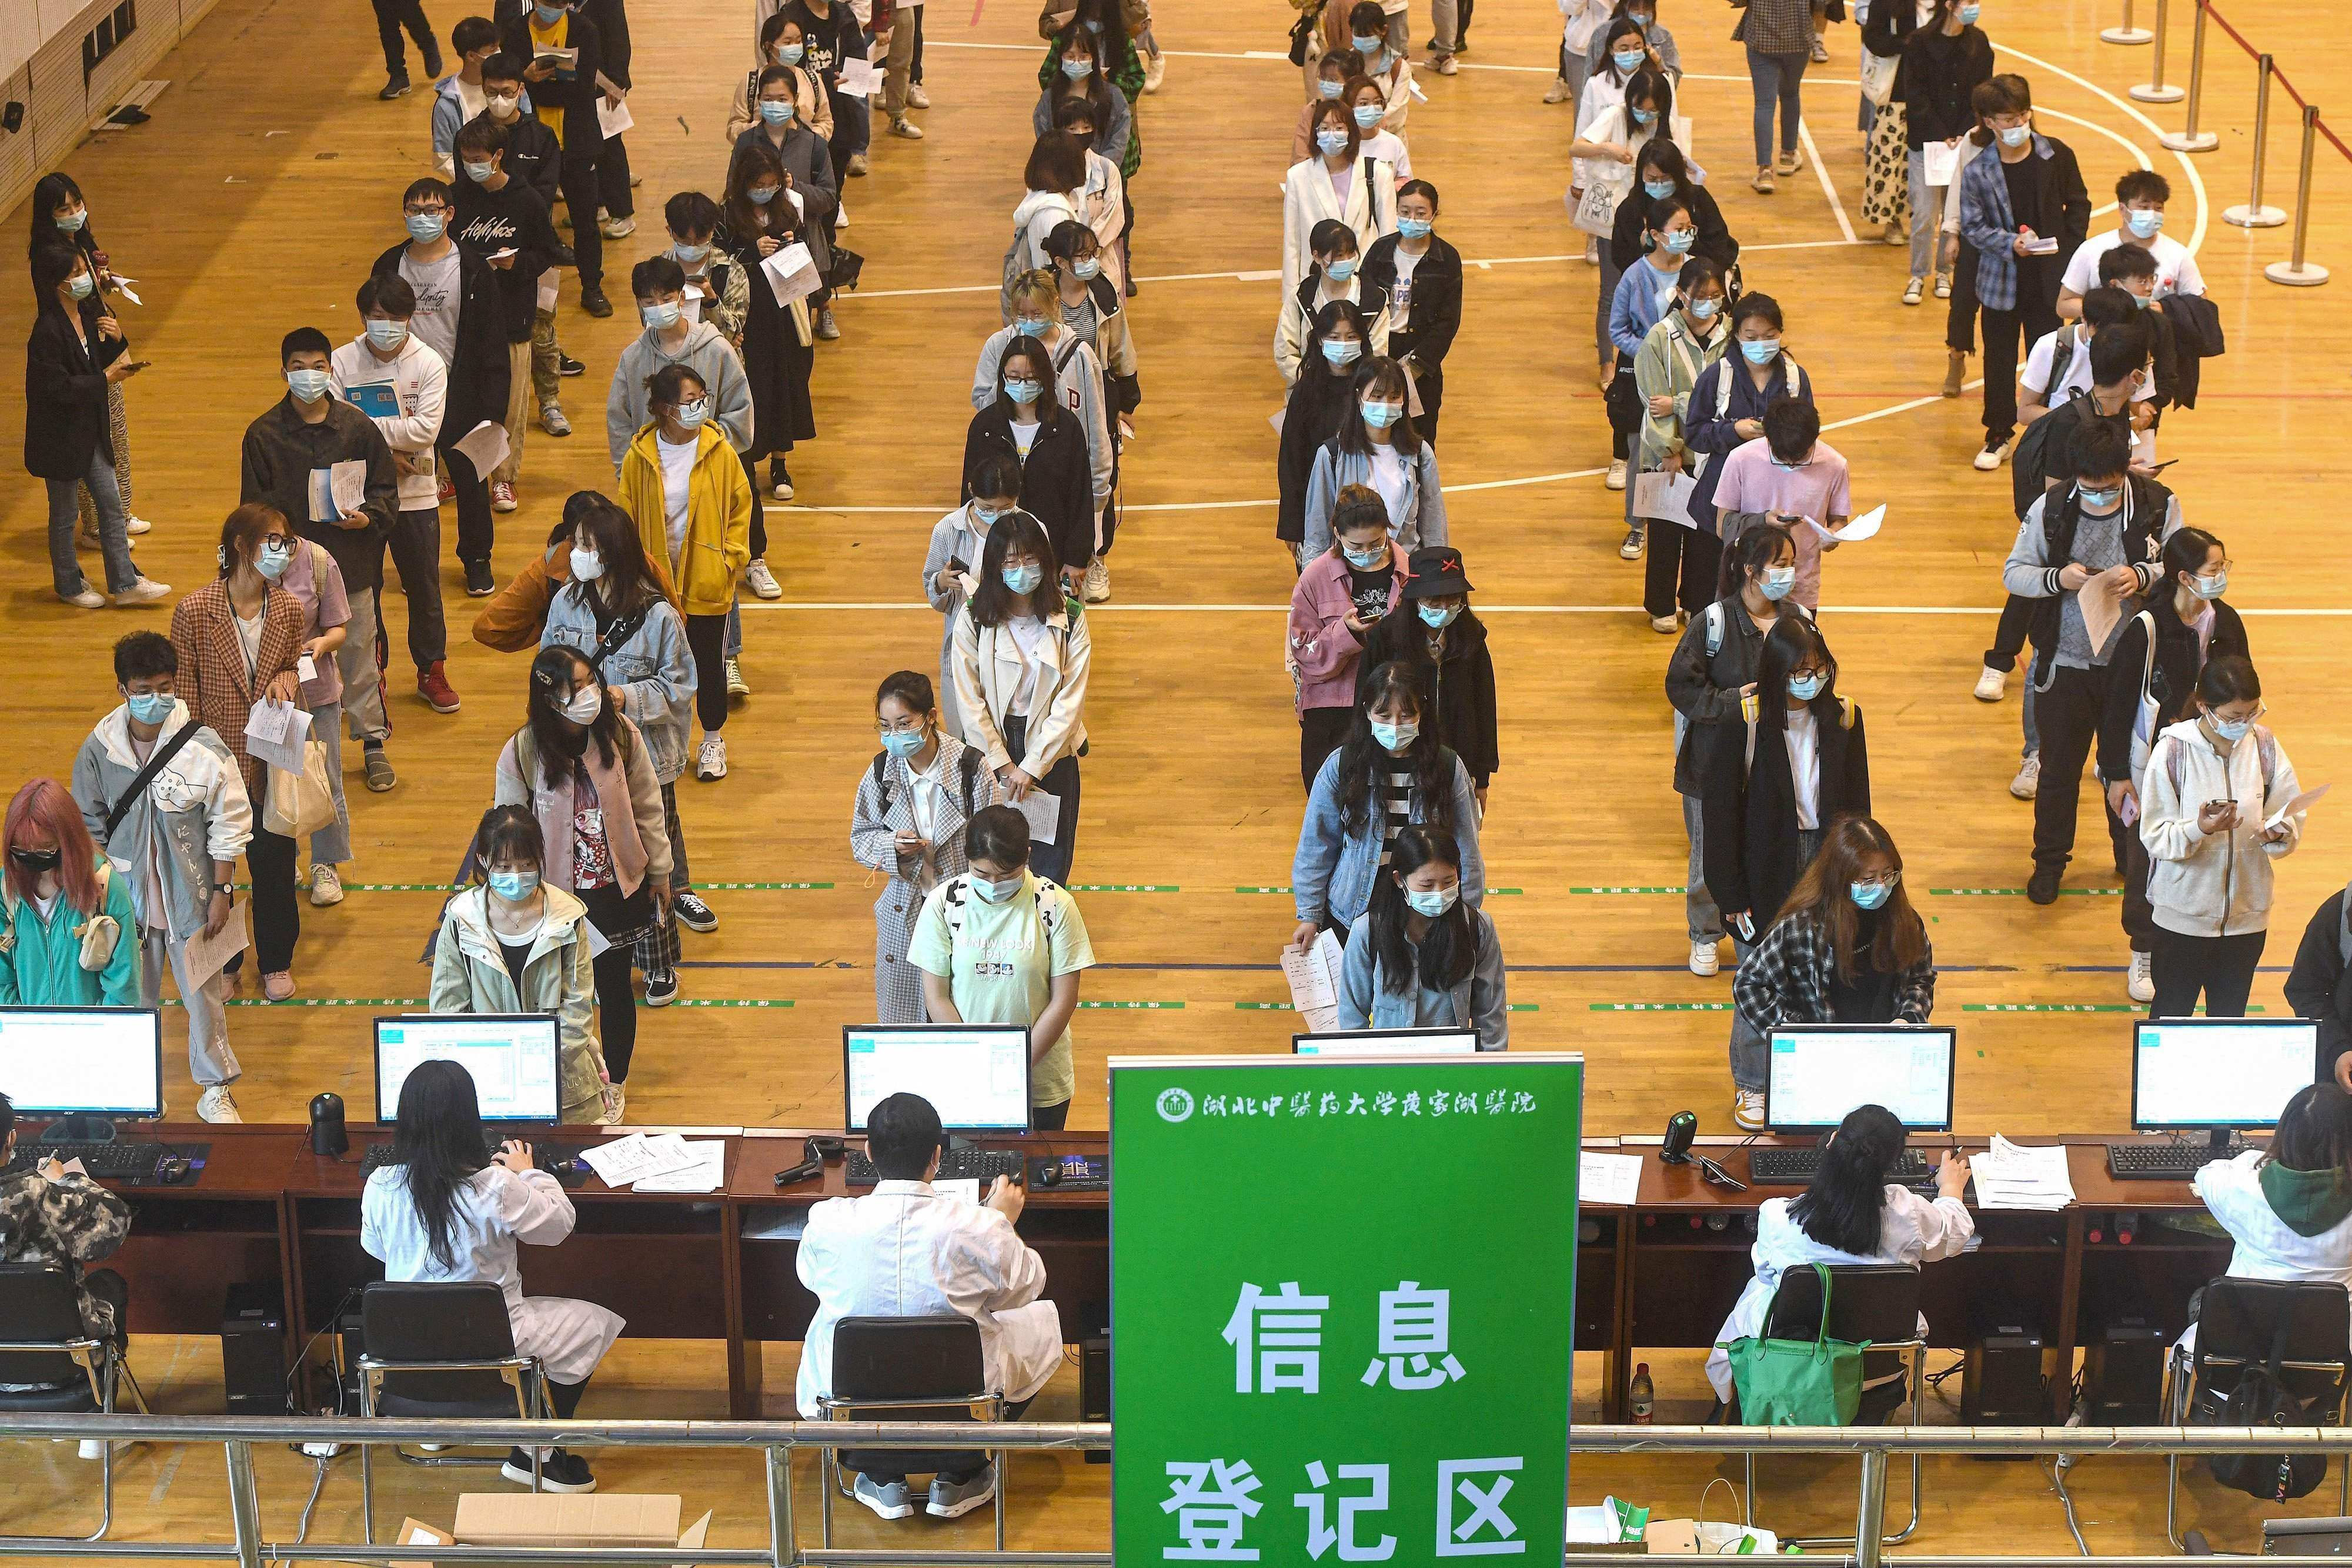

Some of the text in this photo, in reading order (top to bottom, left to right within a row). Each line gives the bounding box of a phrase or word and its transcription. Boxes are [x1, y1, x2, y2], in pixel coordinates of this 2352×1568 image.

[1222, 1281, 1466, 1393] 信息
[1160, 1457, 1525, 1561] 登记区
